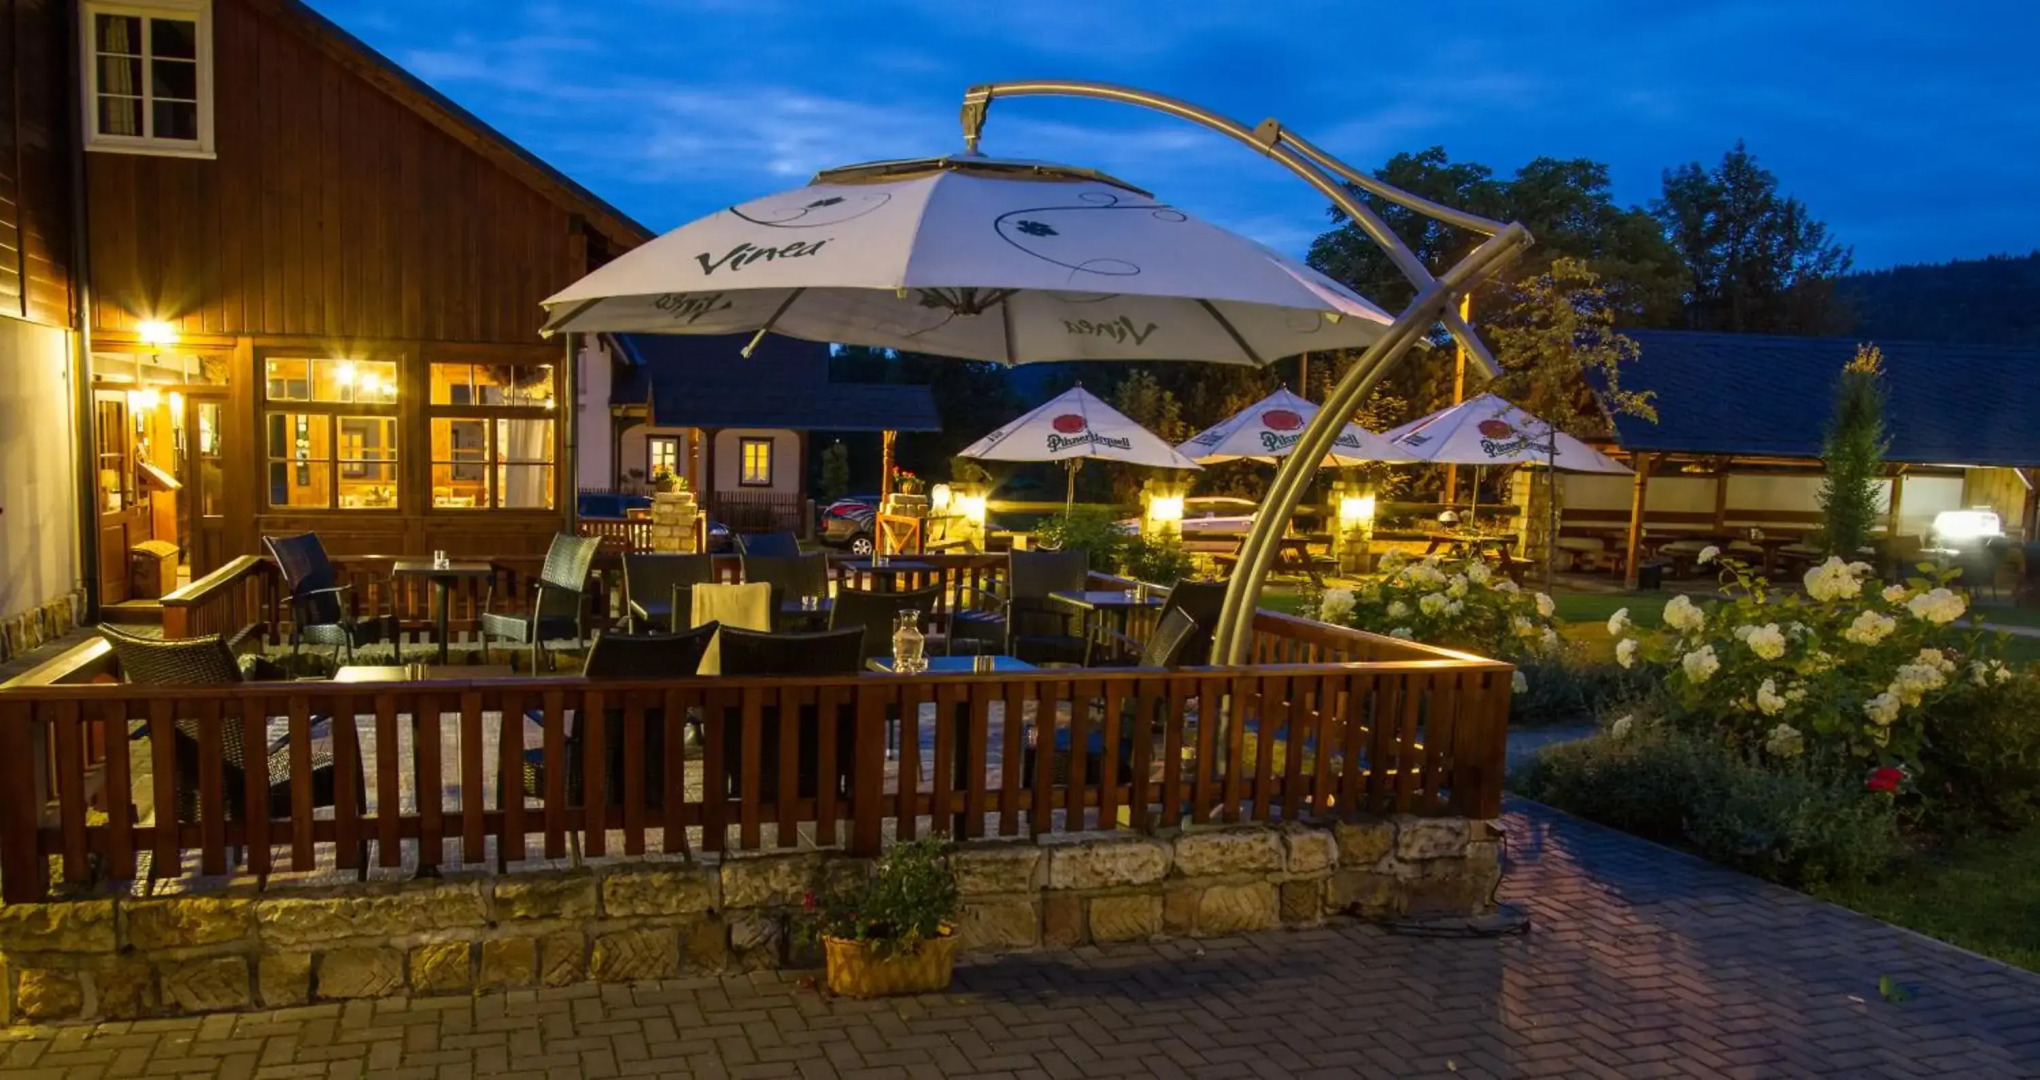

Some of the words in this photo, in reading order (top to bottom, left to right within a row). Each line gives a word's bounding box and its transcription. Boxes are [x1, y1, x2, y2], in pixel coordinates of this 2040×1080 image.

[695, 242, 828, 275] Vinea
[1047, 434, 1090, 452] Pilsner
[1090, 433, 1132, 450] Urquell
[1260, 431, 1302, 452] Pilsn
